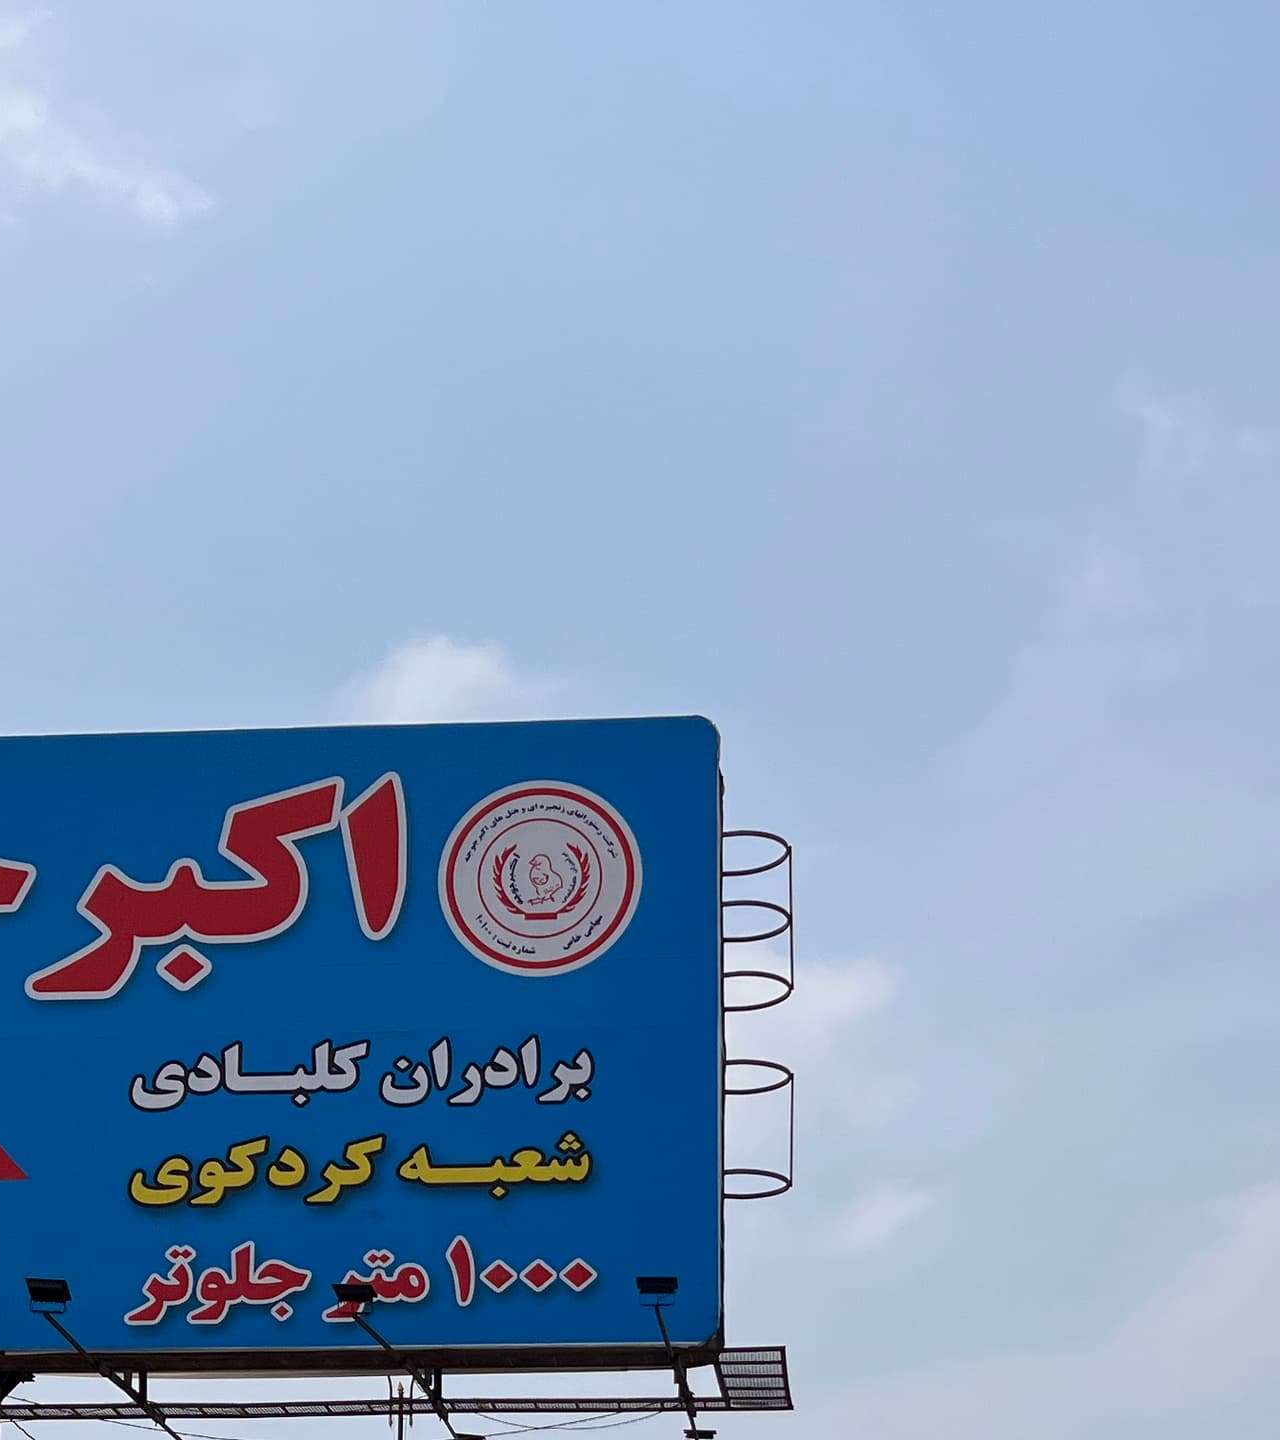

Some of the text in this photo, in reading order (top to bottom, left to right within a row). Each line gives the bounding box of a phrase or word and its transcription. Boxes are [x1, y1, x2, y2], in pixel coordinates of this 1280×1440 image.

[24, 771, 407, 1000] اکبر
[380, 1036, 594, 1106] برادران
[129, 1131, 592, 1207] شعبه کردکوی
[124, 1239, 314, 1327] جلوتر
[445, 1235, 599, 1308] ۱۰۰۰
